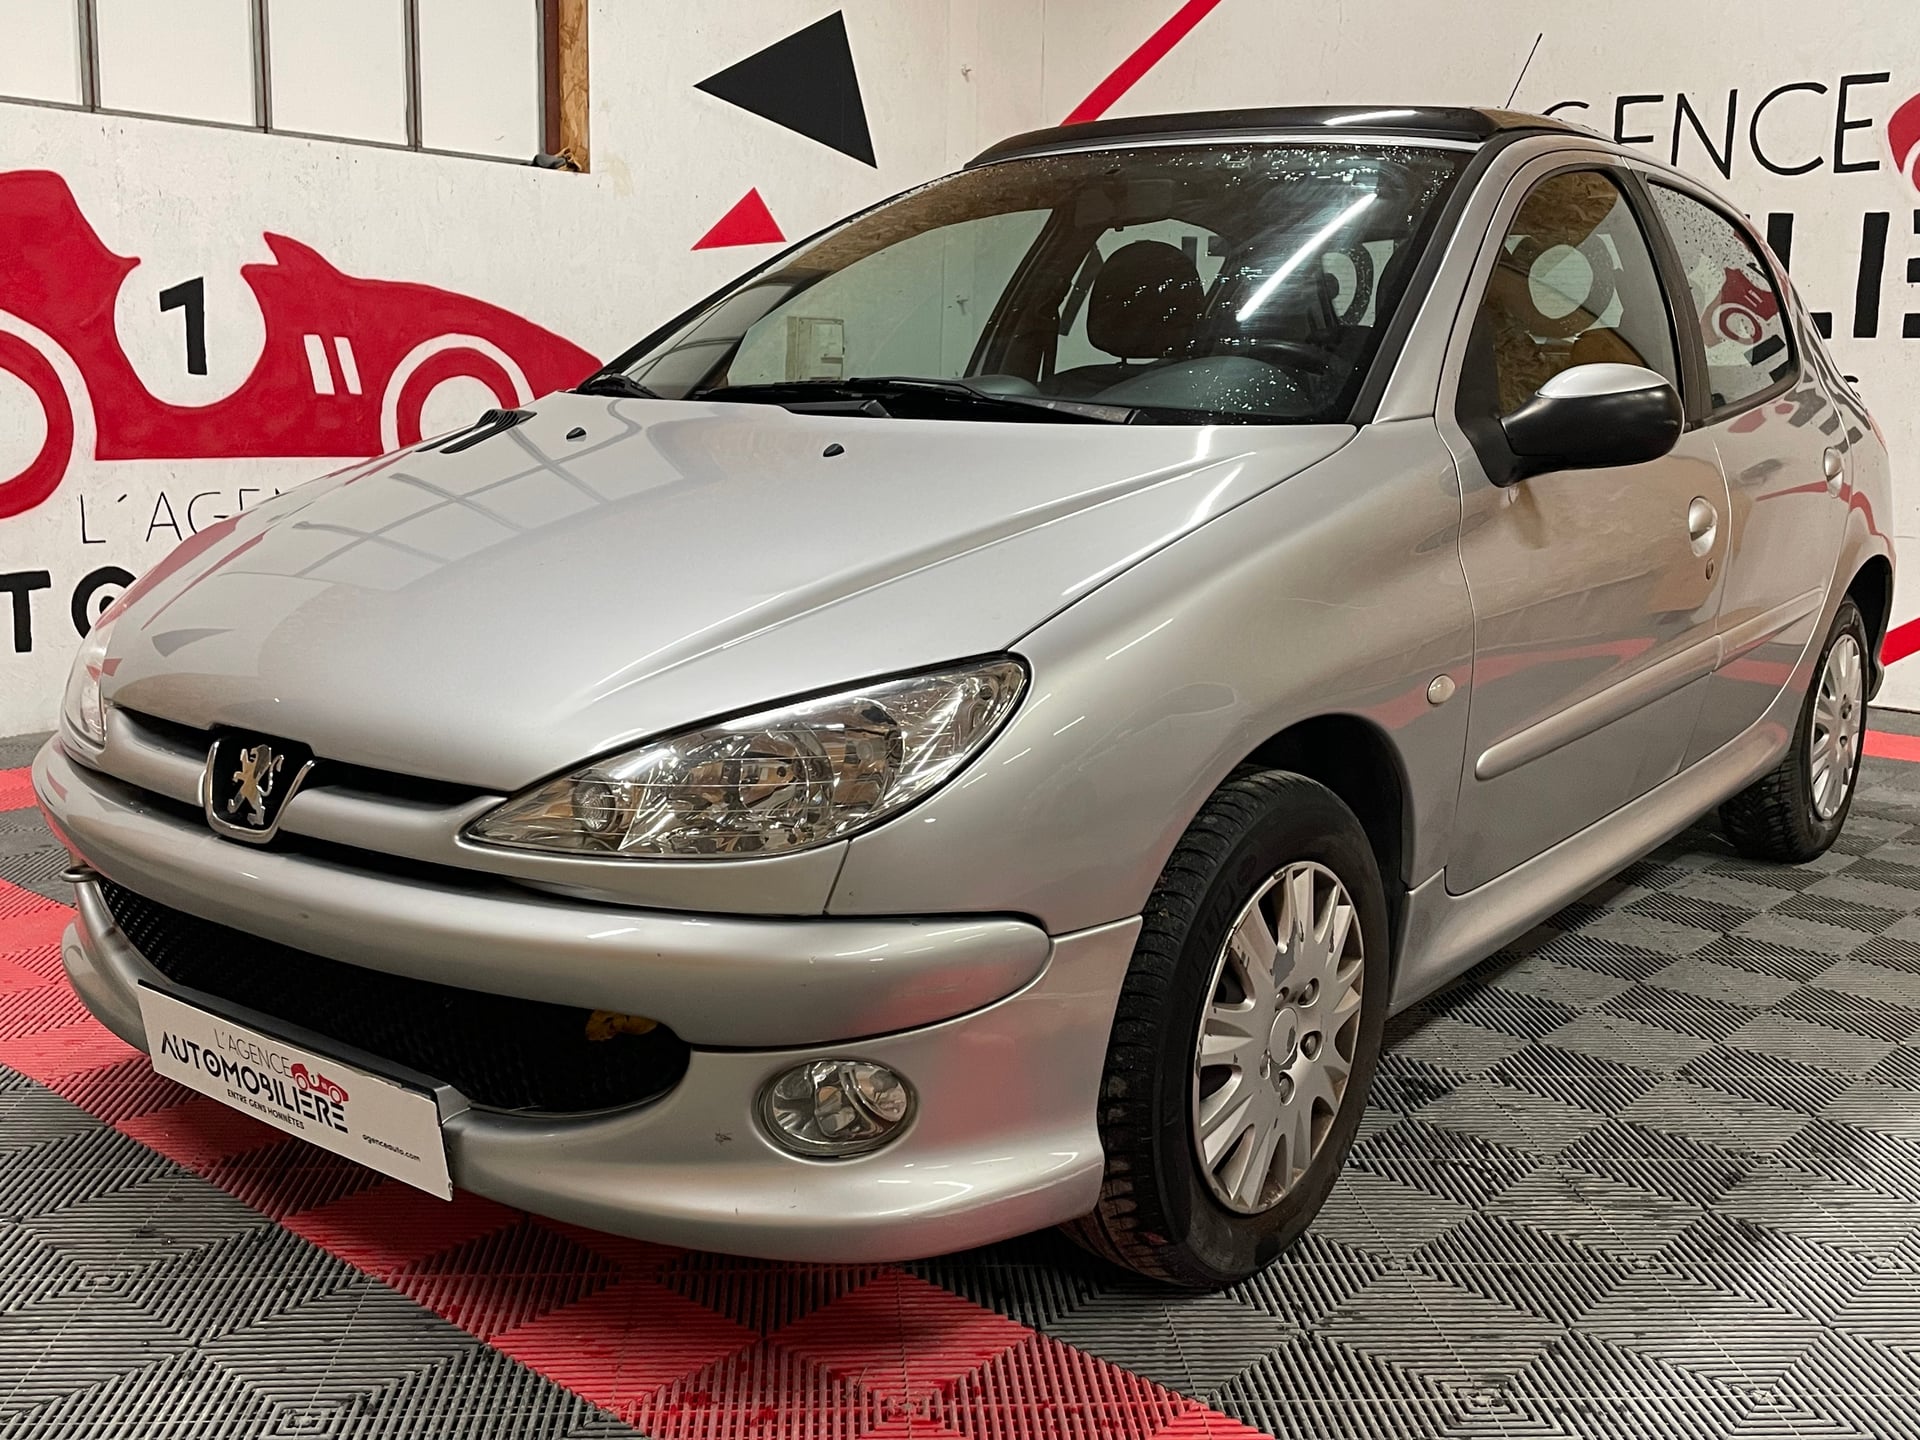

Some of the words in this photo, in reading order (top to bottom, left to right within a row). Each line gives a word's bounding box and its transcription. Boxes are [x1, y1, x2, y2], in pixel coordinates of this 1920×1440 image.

[1543, 72, 1890, 179] ENCE
[159, 276, 207, 375] 1
[213, 1028, 293, 1079] L'AGENCE
[227, 1088, 248, 1105] ENTRE
[248, 1099, 267, 1113] GENS
[362, 1134, 421, 1162] agenceauto.com
